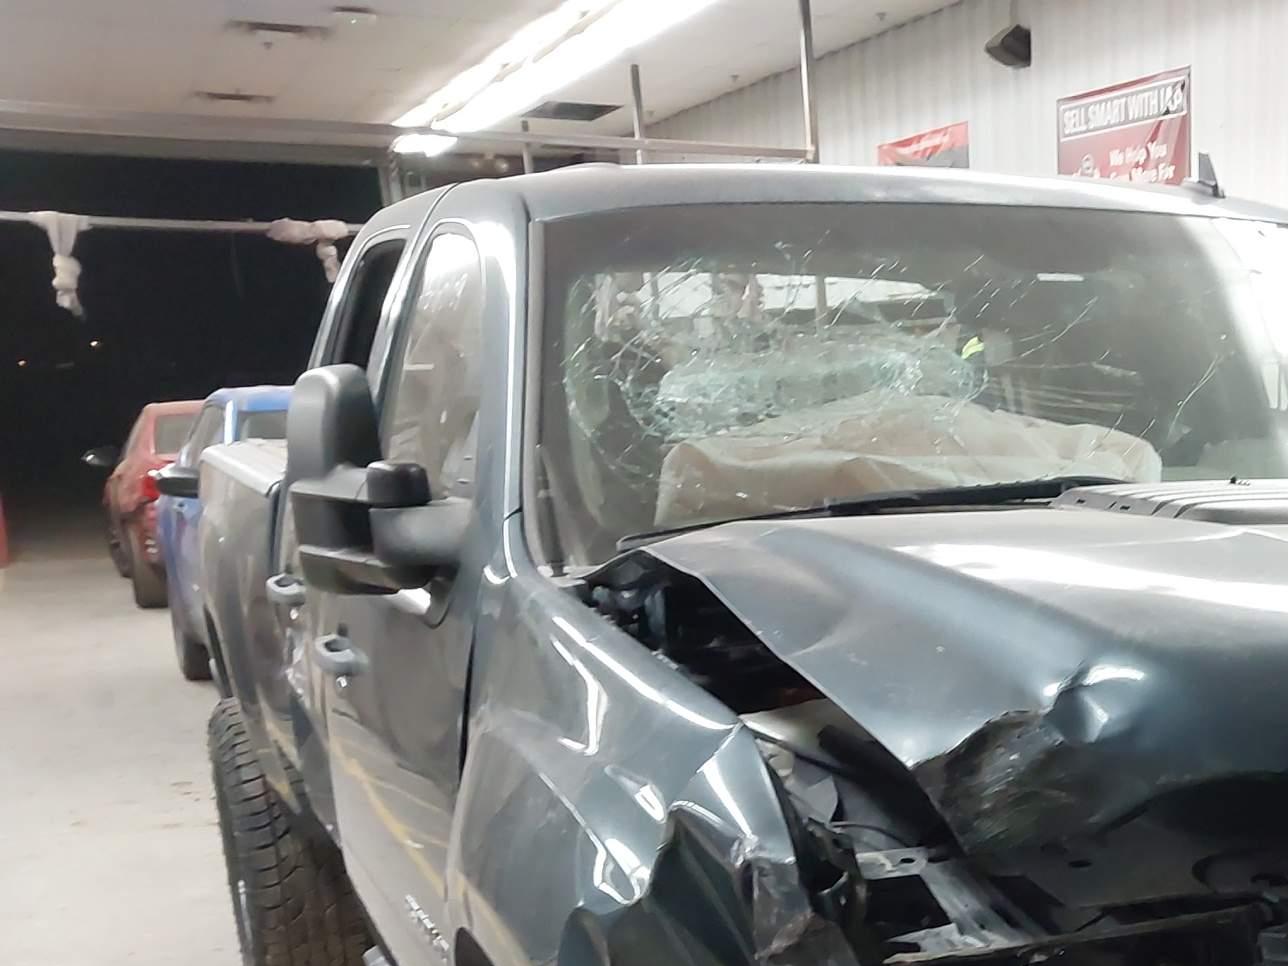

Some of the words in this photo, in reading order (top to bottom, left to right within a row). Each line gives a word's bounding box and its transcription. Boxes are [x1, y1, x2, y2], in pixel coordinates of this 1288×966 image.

[1063, 107, 1088, 135] SELL
[1087, 97, 1127, 129] SMART
[1126, 89, 1159, 120] WITH
